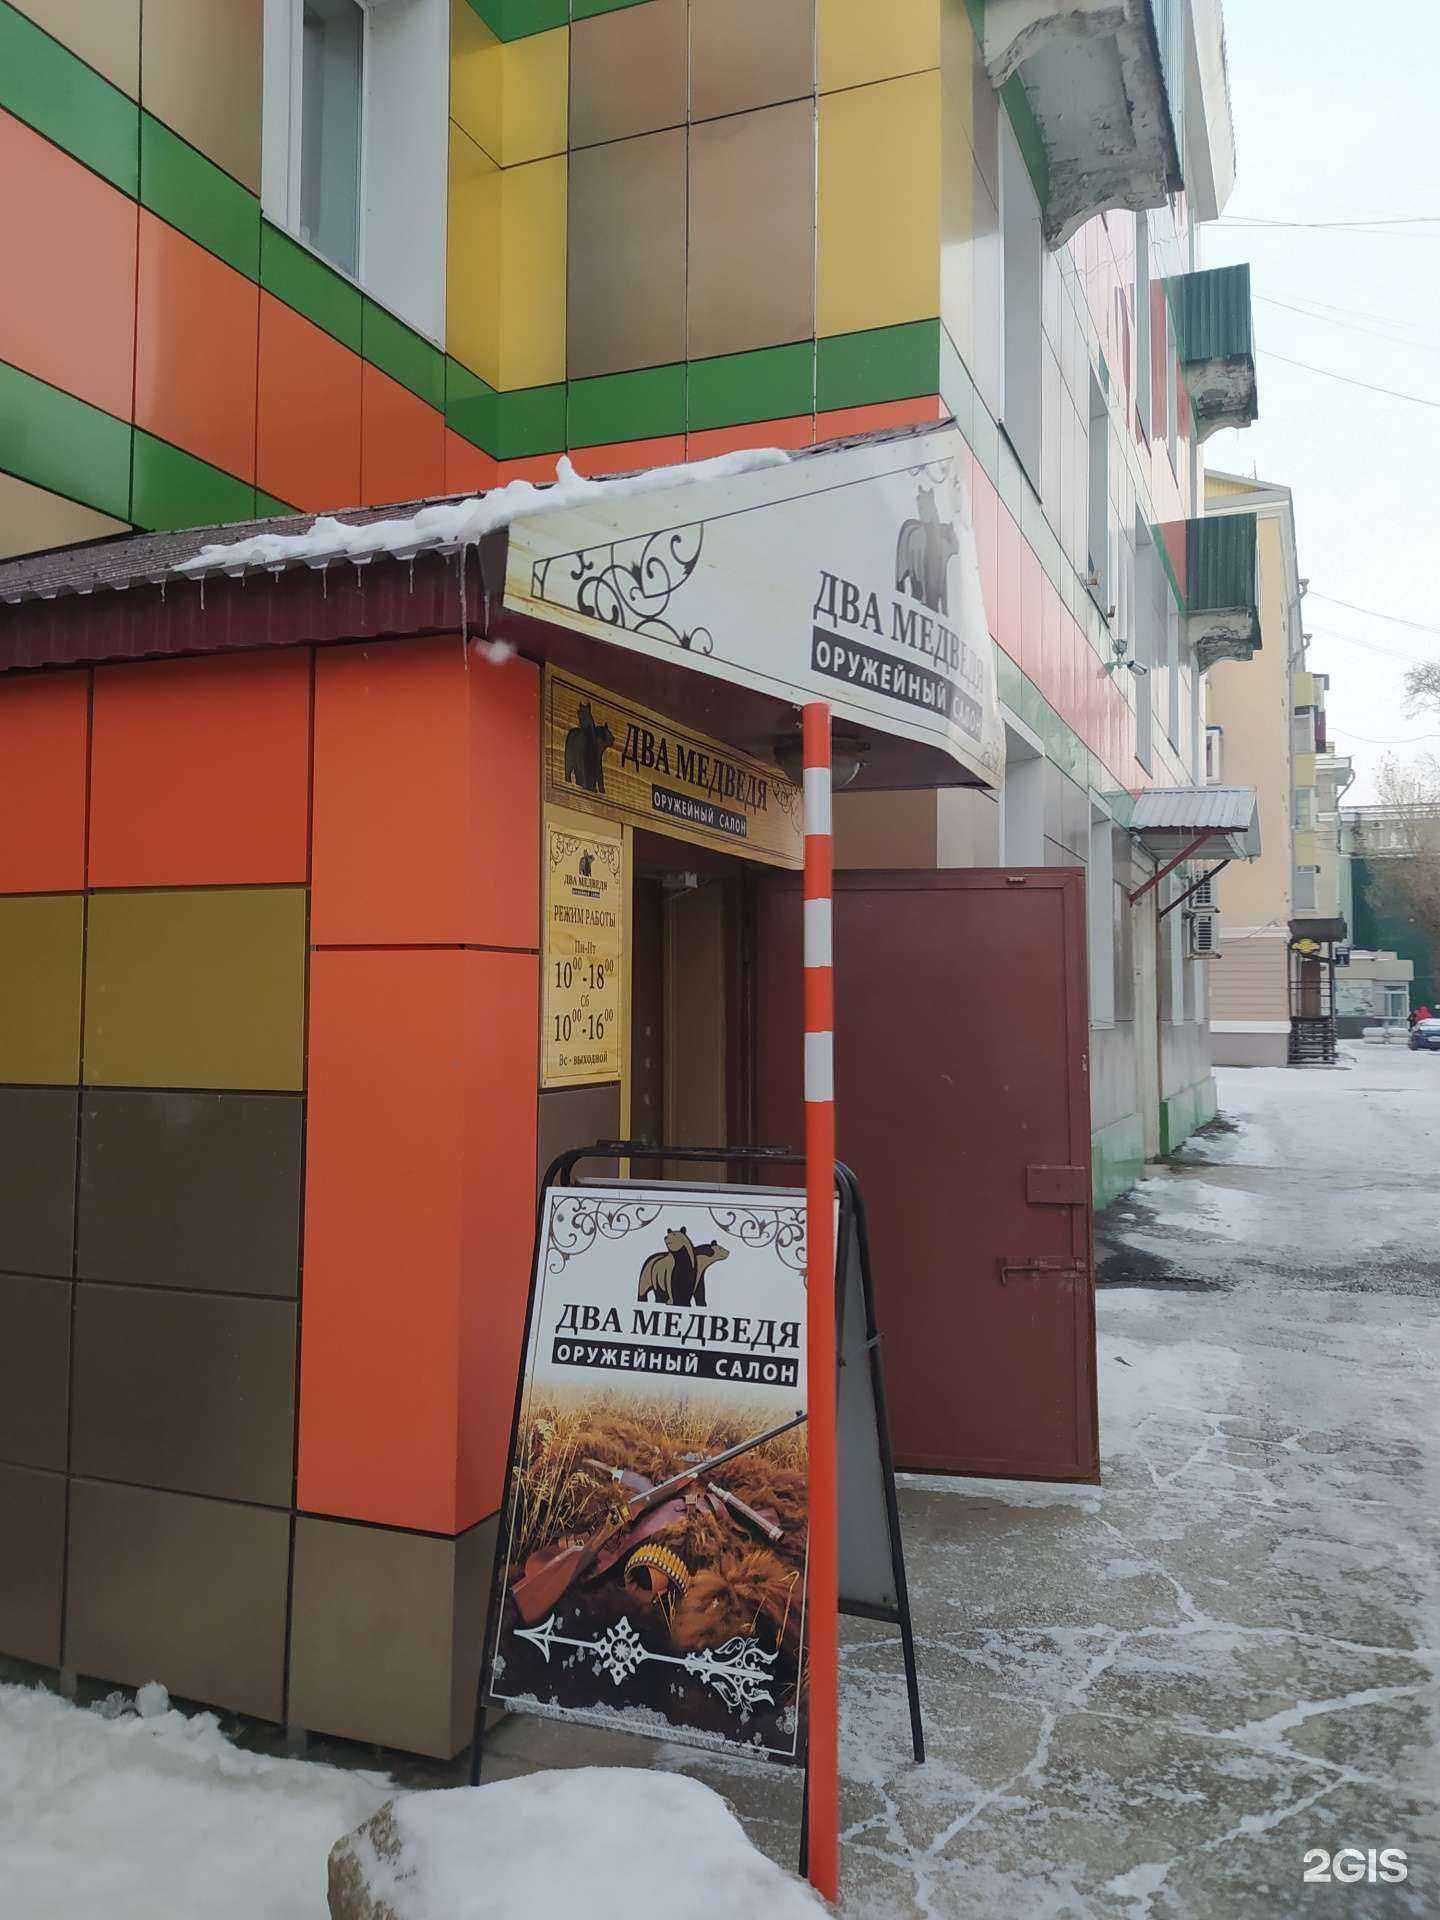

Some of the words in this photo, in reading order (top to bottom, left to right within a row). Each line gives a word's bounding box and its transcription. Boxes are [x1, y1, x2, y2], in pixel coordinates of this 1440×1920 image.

[813, 570, 884, 636] ДВА
[816, 641, 947, 711] ОРУЖЕЙНЫЙ
[621, 723, 671, 775] ДВА
[675, 743, 768, 815] МЕДВЕДЯ
[654, 791, 715, 823] ОРУЖЕЙНЫЙ
[719, 813, 747, 835] САЛОН
[554, 904, 584, 925] РЕЖИМ
[585, 910, 616, 928] РАБОТЫ
[580, 994, 590, 1008] Сб
[573, 1051, 608, 1065] выходной
[555, 1303, 622, 1335] ДВА
[631, 1309, 802, 1354] МЕДВЕДЯ
[556, 1343, 699, 1374] ОРУЖЕЙНЫЙ
[714, 1358, 796, 1384] САЛОН
